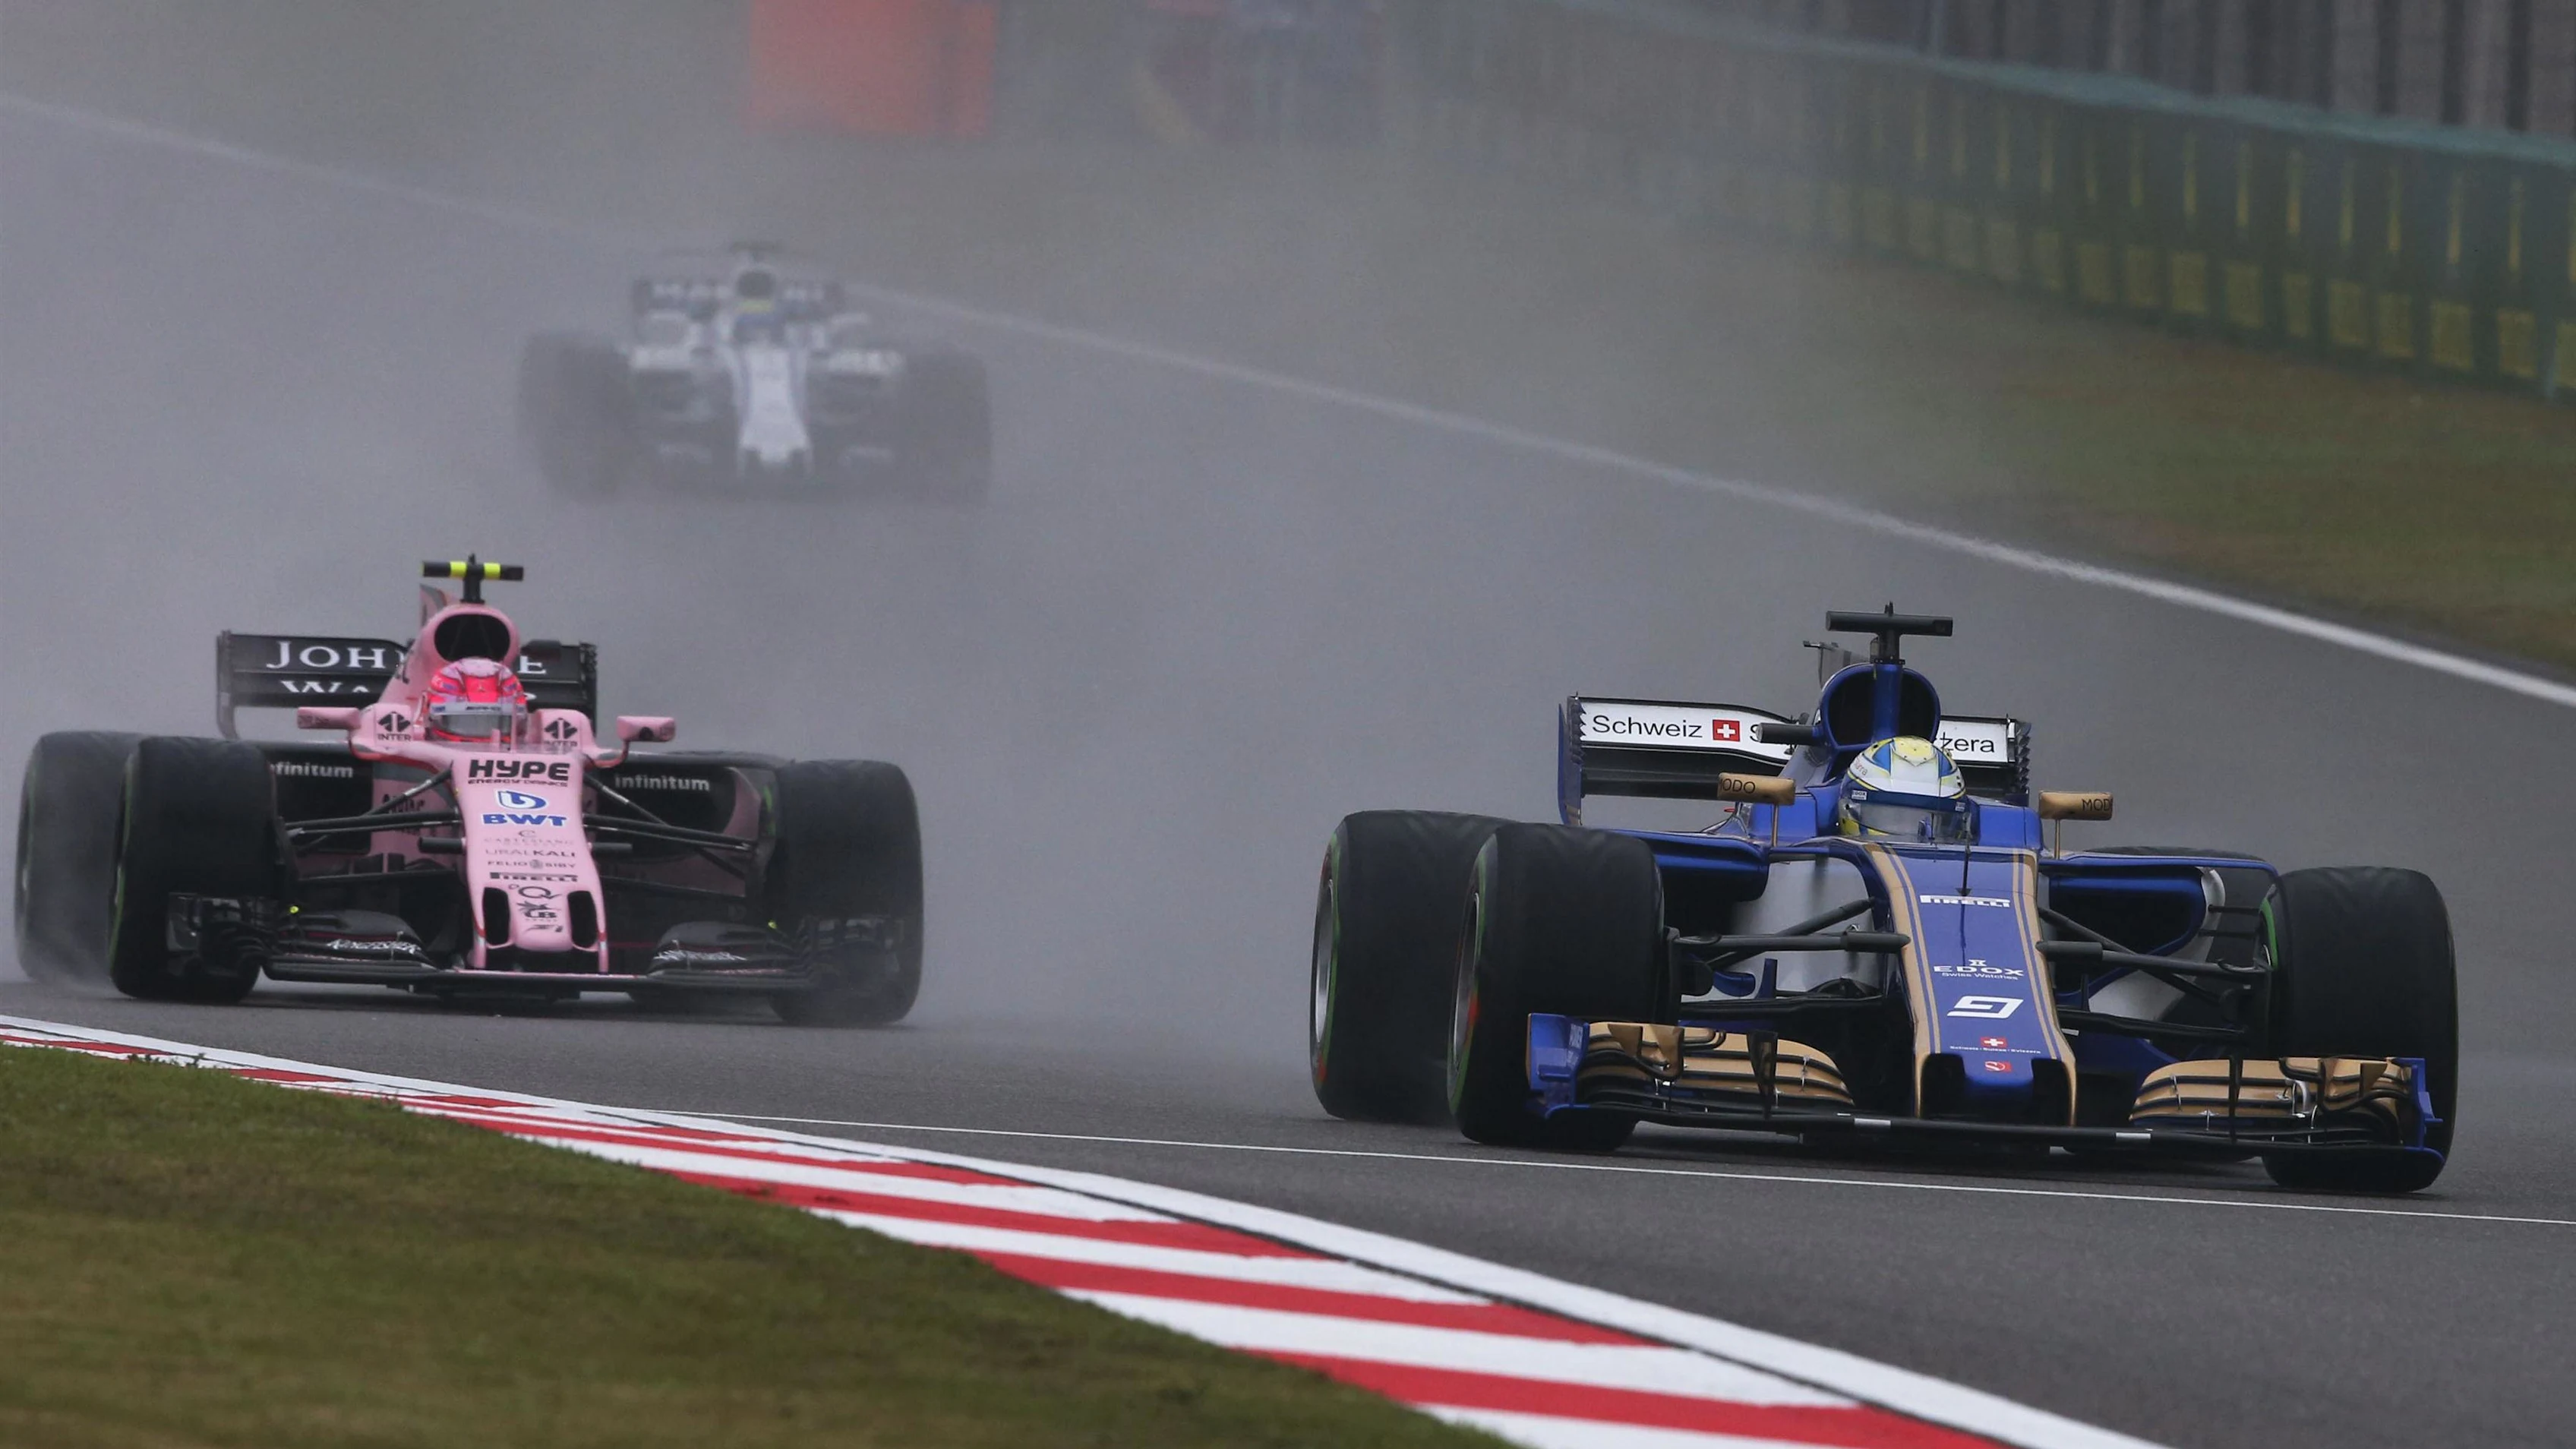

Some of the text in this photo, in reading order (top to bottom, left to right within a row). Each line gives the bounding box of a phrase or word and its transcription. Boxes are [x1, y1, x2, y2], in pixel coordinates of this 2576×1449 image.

[1593, 715, 1703, 738] Schweiz
[377, 734, 411, 742] INTER
[469, 759, 570, 781] HYPE
[615, 775, 710, 791] infinitum
[1719, 778, 1756, 794] ODO
[482, 813, 567, 827] BWT
[1920, 895, 2011, 908] PIRELLI
[1934, 965, 2025, 977] EDOX
[1946, 995, 2024, 1019] 9
